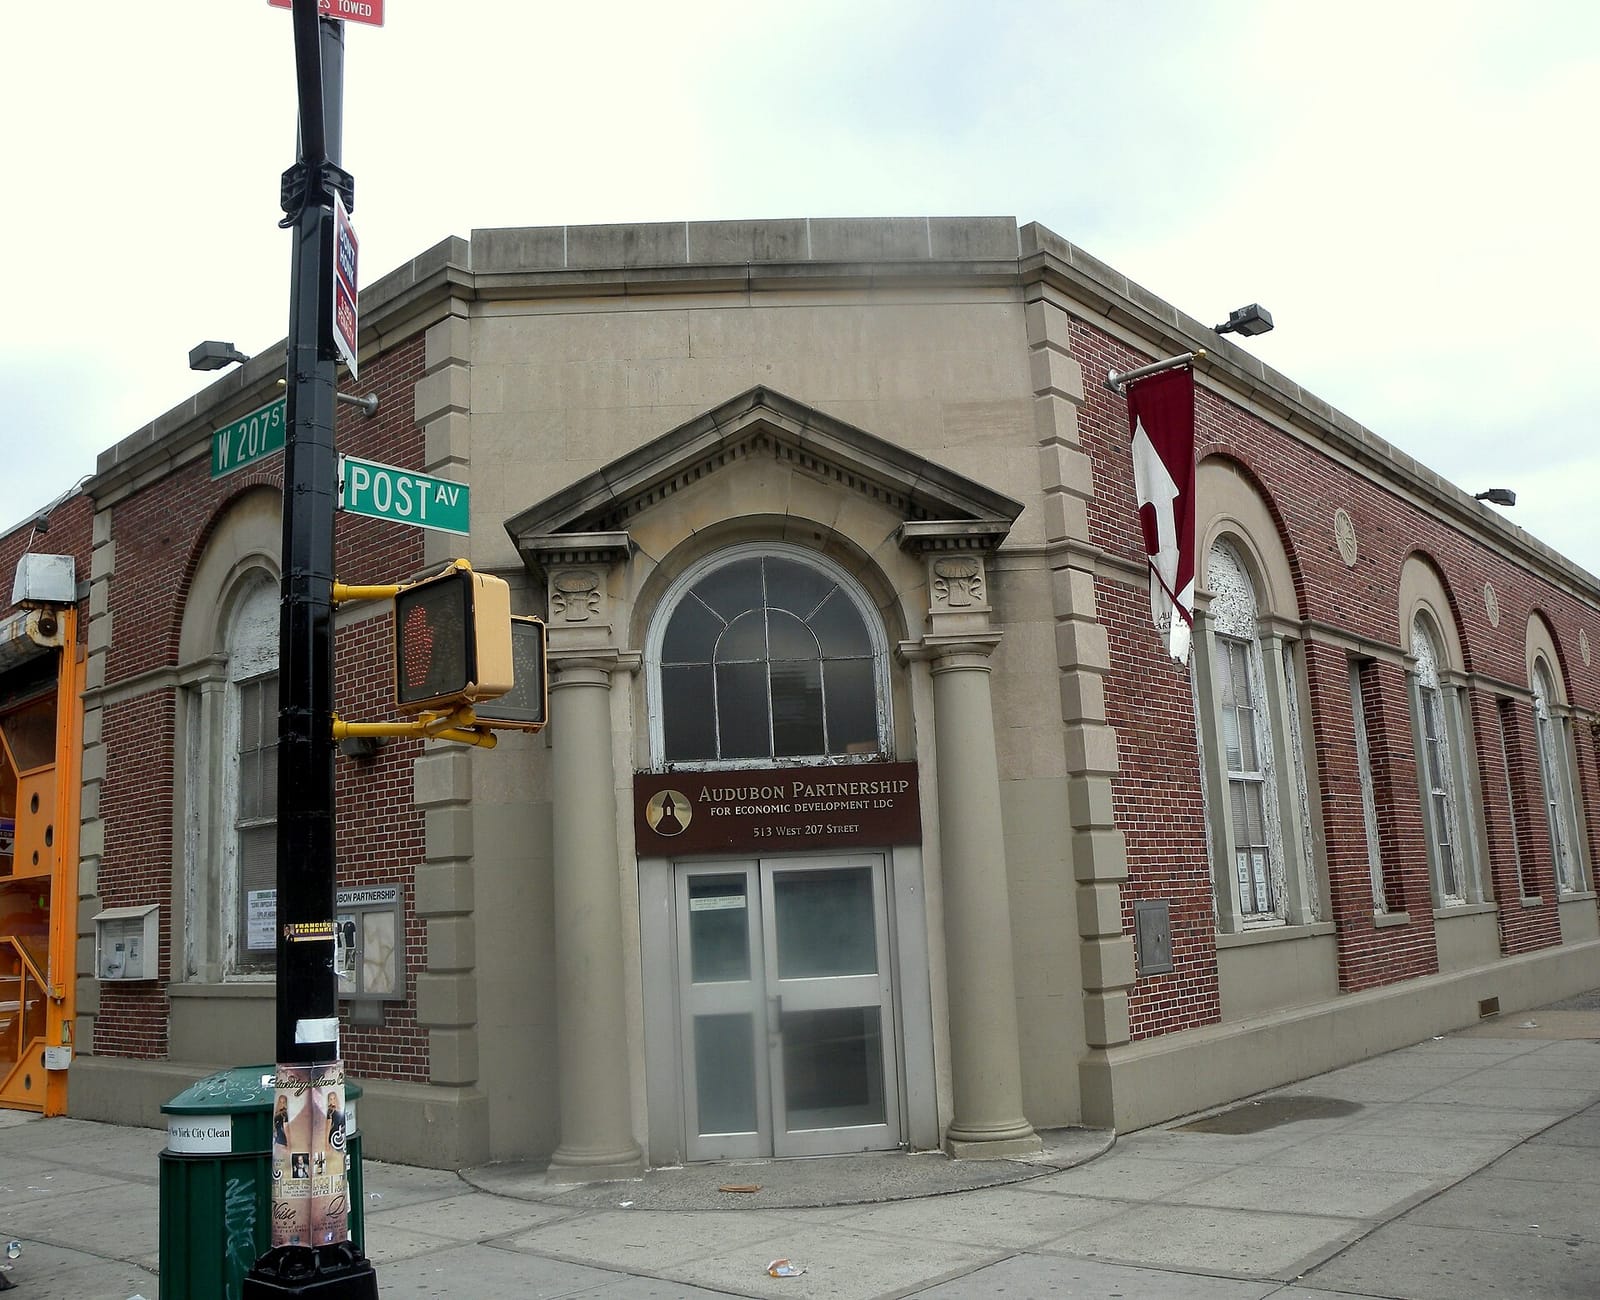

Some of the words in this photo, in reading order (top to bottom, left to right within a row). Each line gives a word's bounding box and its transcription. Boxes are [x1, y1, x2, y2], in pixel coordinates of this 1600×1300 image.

[338, 0, 372, 17] TOWED
[219, 430, 231, 471] W
[237, 411, 271, 462] 207
[271, 403, 287, 428] ST
[351, 466, 432, 519] POST
[435, 484, 460, 507] AV
[698, 785, 785, 802] AUDUBON
[792, 780, 909, 798] PARTNERSHIP
[710, 807, 732, 817] FOR
[735, 804, 791, 815] ECONOMIC
[794, 800, 869, 813] DEVELOPMENT
[873, 799, 894, 809] LDC
[753, 826, 772, 838] 513
[775, 826, 802, 836] WEST
[804, 824, 824, 835] 207
[826, 823, 860, 834] STREET
[352, 890, 396, 902] PARTNERSHIP
[178, 1127, 191, 1138] York
[191, 1127, 206, 1141] City
[207, 1127, 230, 1138] Clean
